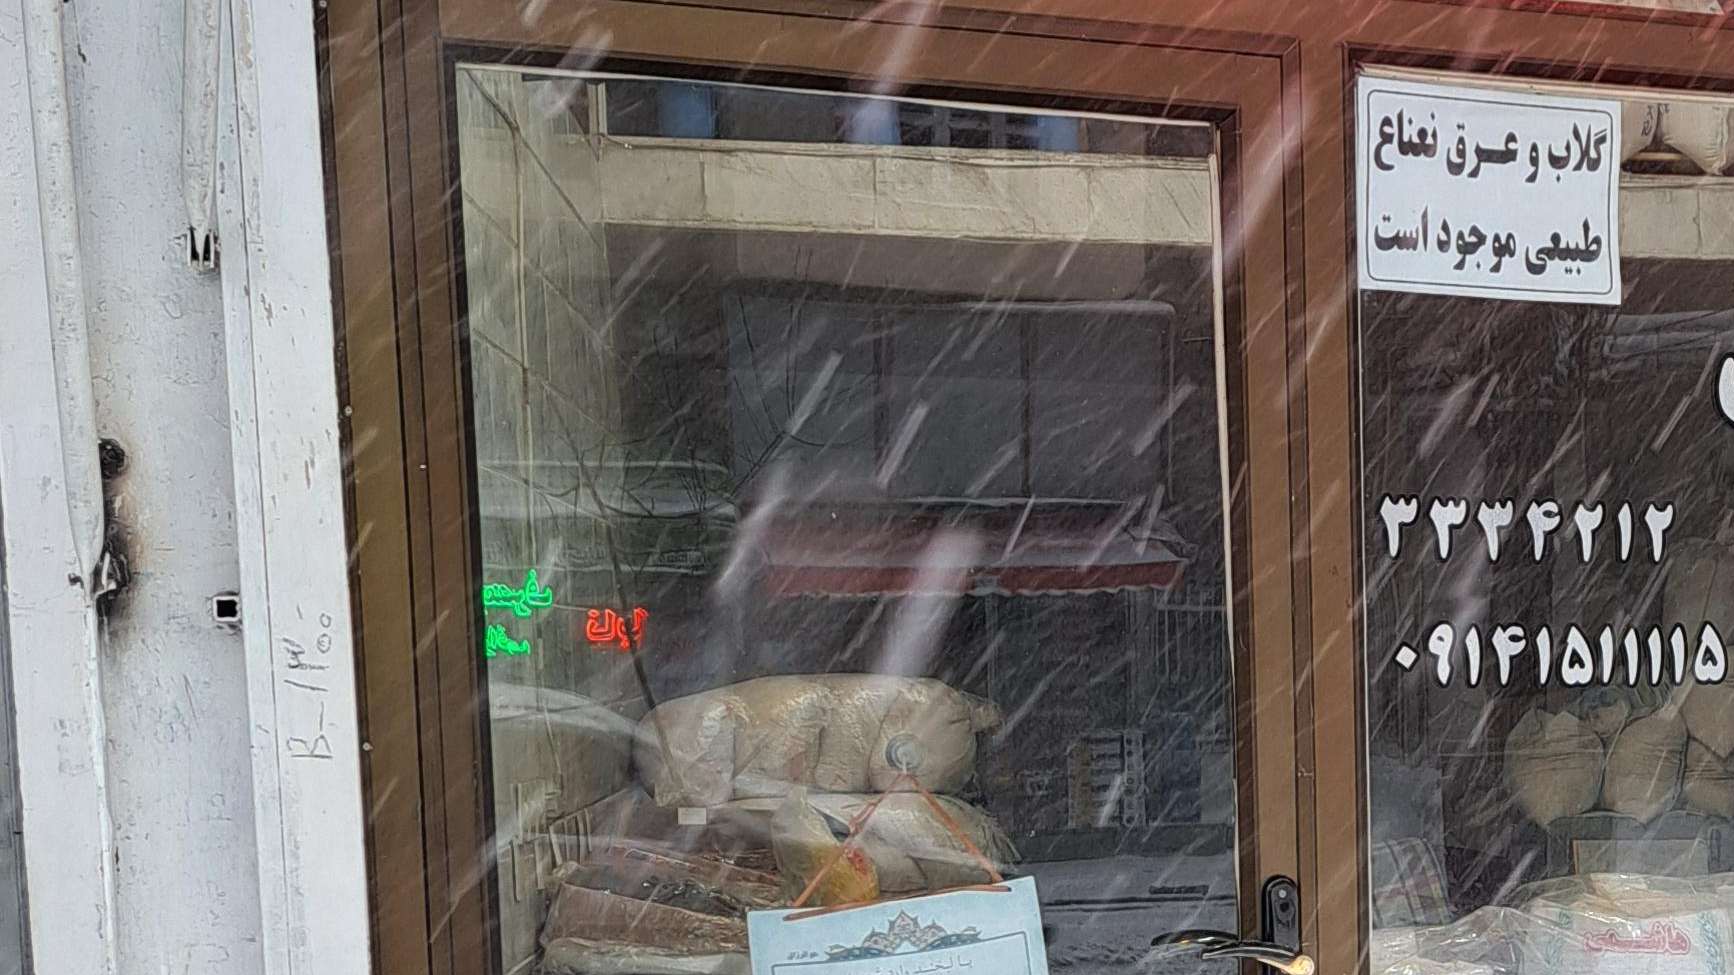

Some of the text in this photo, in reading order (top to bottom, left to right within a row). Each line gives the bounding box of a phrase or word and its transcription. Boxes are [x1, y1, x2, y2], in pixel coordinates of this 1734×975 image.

[1374, 107, 1608, 184] گلاب و عرق نعناع
[1374, 204, 1602, 276] طبیعی موجود است
[1378, 494, 1676, 565] ۳۳۳۴۲۱۲
[1393, 622, 1727, 688] ۰۹۱۴۱۵۱۱۱۱۵
